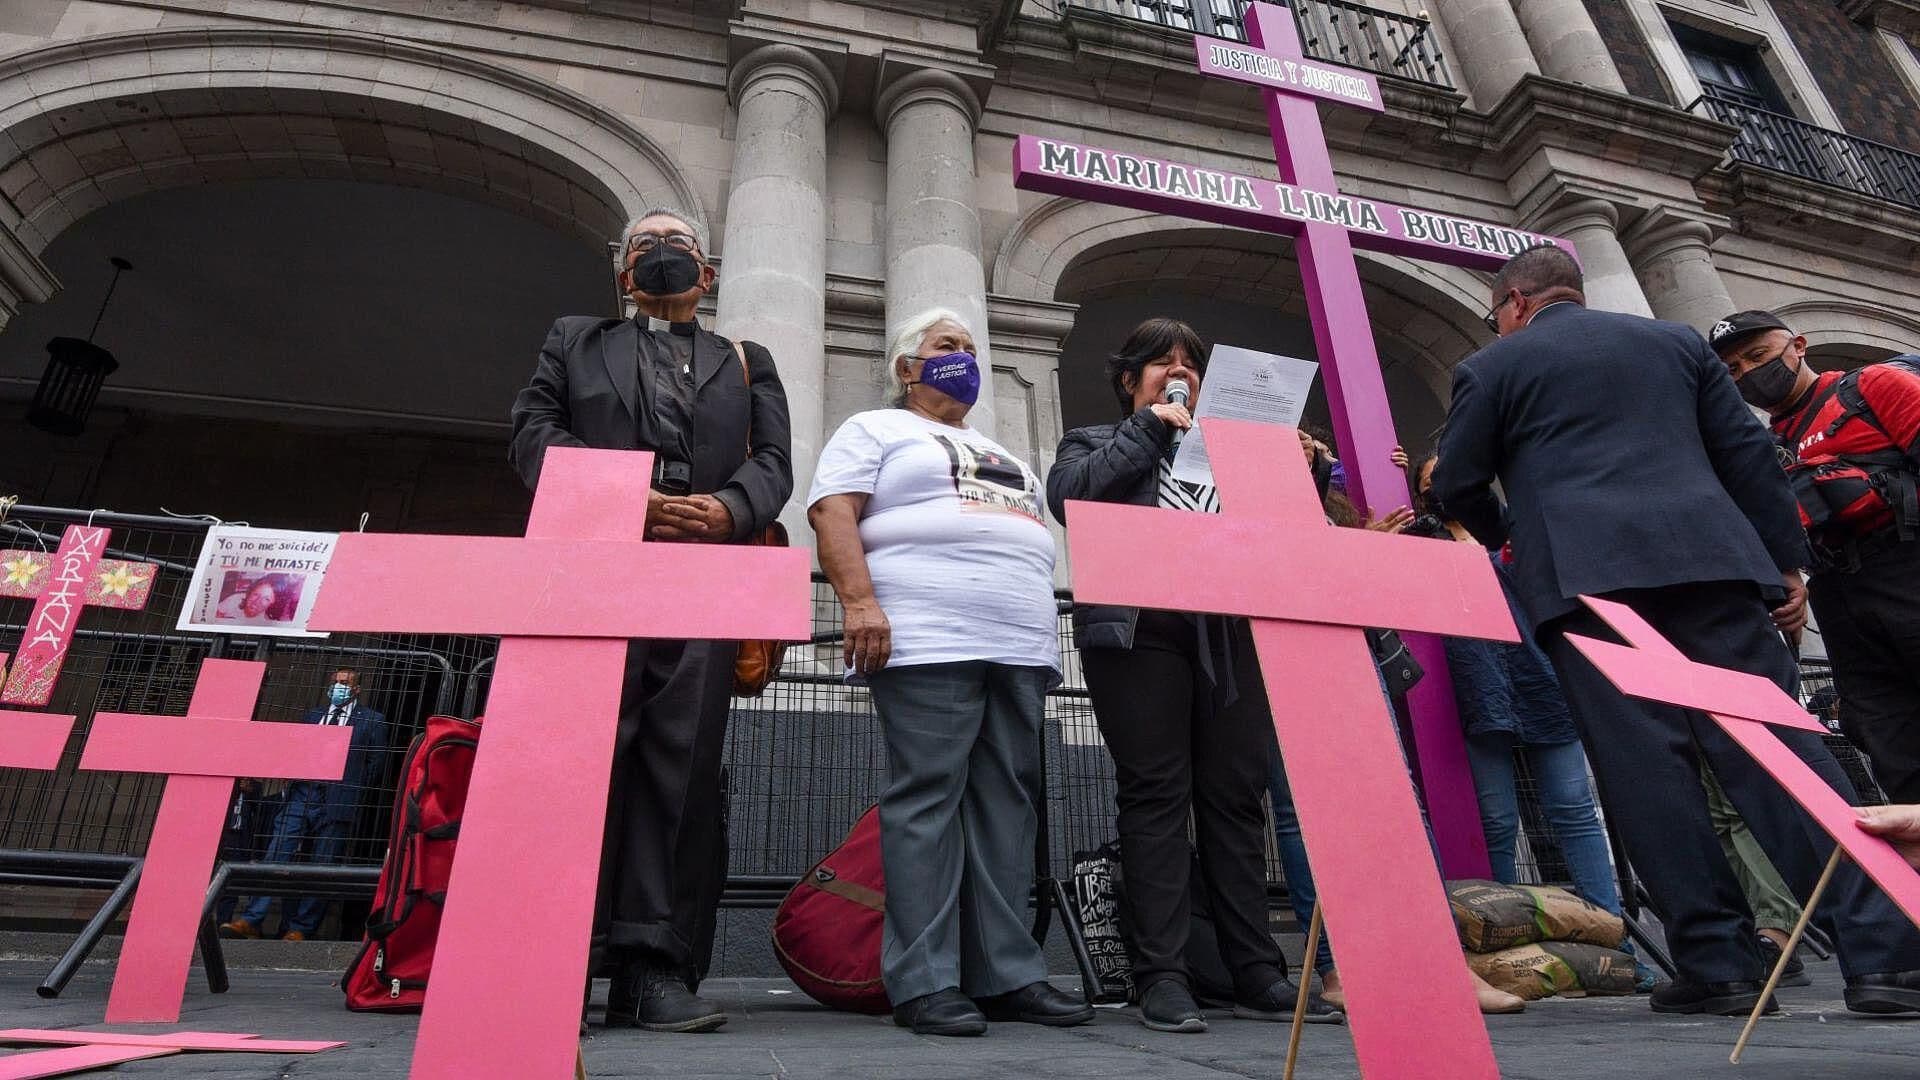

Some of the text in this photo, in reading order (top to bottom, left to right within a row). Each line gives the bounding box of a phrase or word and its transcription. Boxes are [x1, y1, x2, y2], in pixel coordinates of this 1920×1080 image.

[1210, 45, 1373, 102] JUSTICIA Y JUSTICIA
[1038, 140, 1556, 257] MARIANA LIMA BUENDI
[939, 369, 967, 379] JUSTICIA
[218, 538, 233, 550] Yo
[239, 541, 255, 550] no
[258, 543, 274, 551] me
[244, 556, 262, 567] ME
[28, 526, 104, 650] MARIANA
